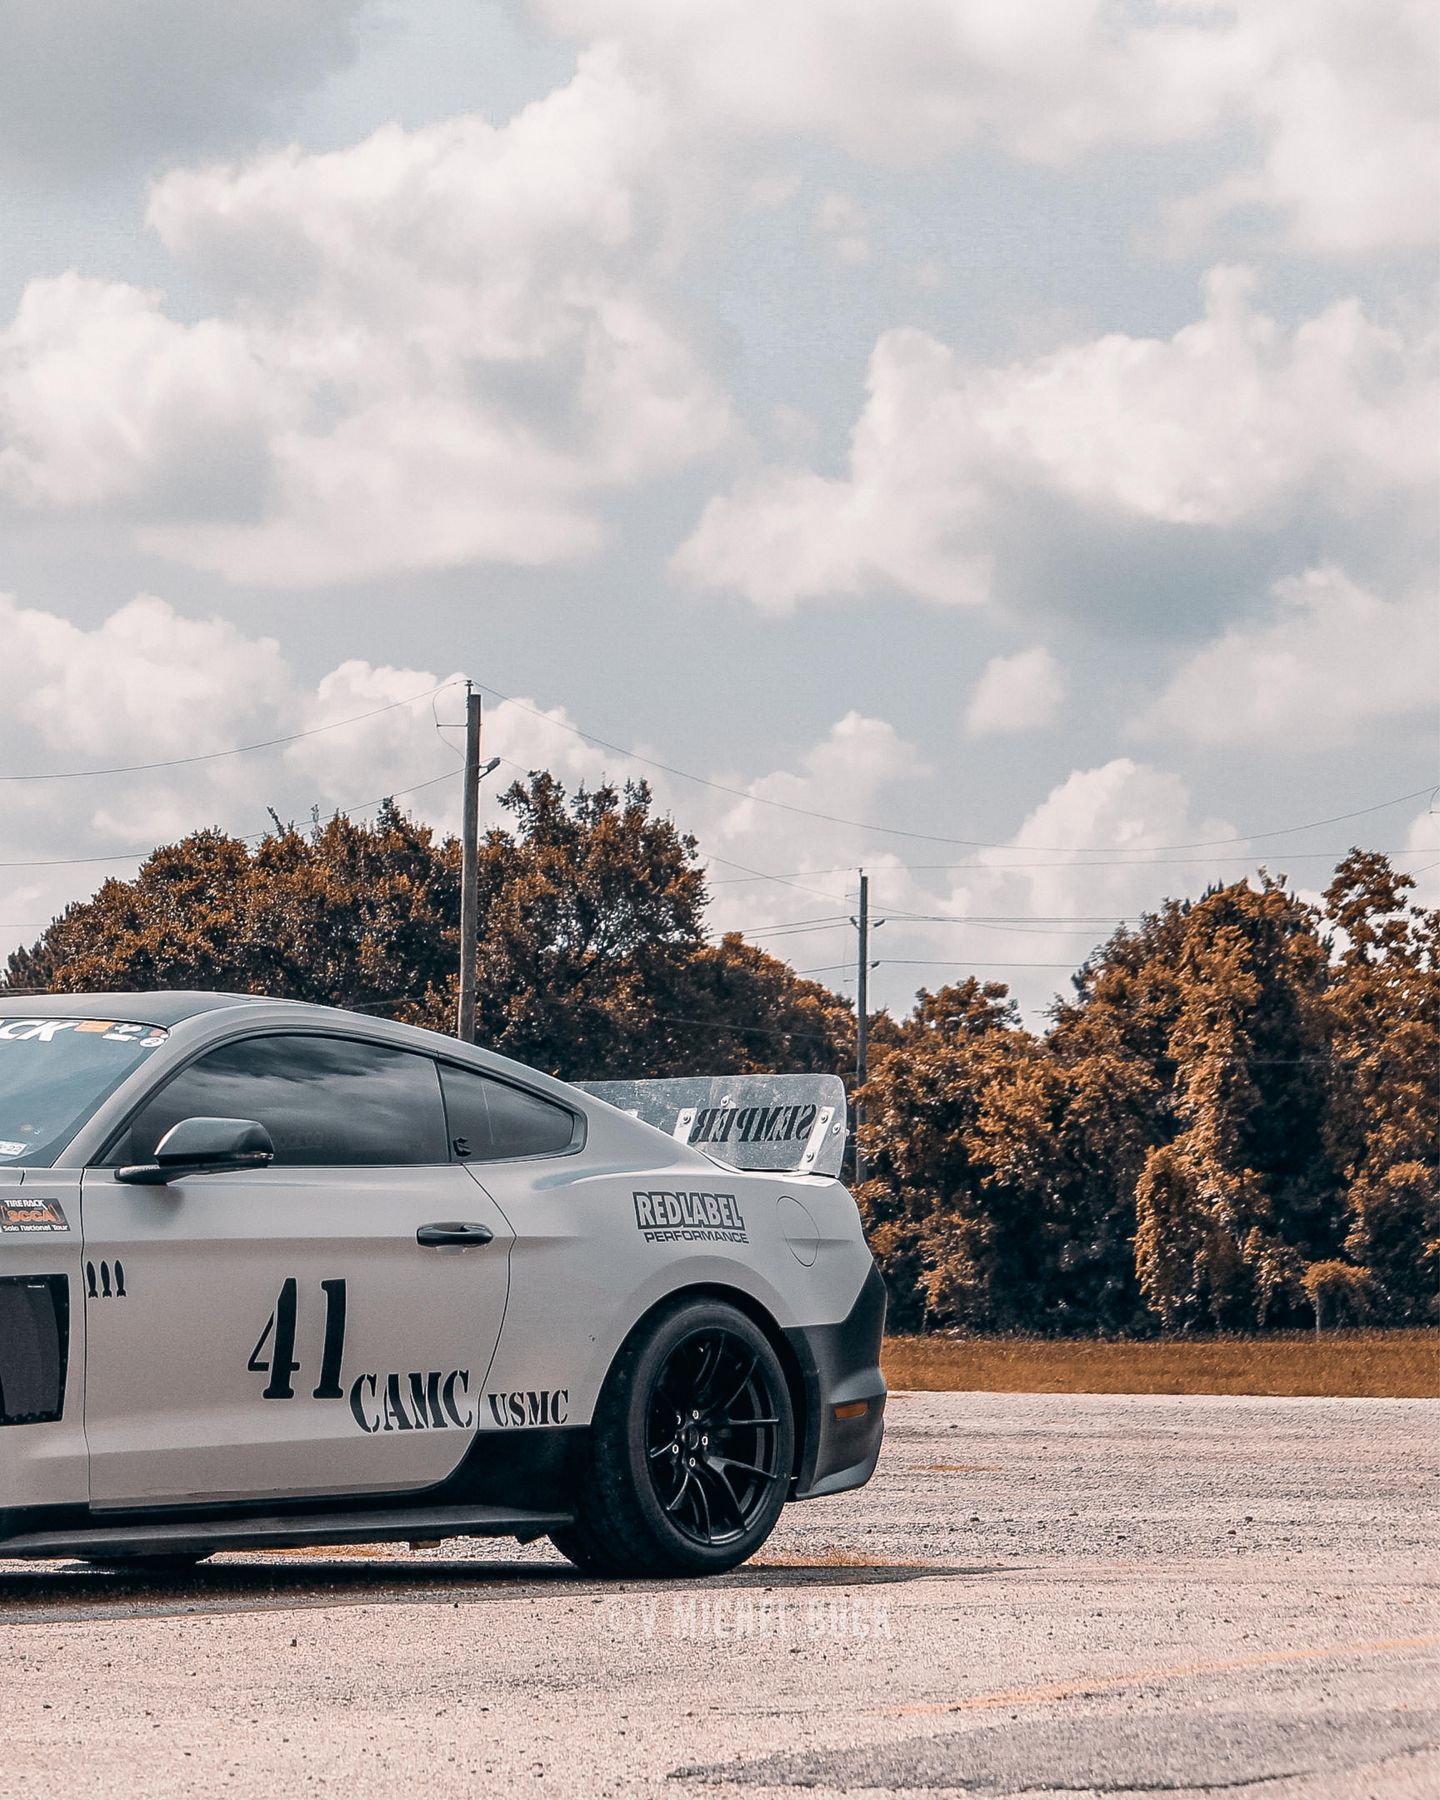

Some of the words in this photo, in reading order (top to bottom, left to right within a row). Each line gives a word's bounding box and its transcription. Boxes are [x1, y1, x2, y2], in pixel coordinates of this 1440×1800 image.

[4, 1199, 23, 1208] TIRE
[23, 1199, 48, 1210] RACK
[7, 1209, 57, 1223] SCCA
[633, 1191, 746, 1231] REDLABEL
[2, 1224, 20, 1232] Solo
[644, 1230, 750, 1244] PERFORMANCE
[247, 1276, 347, 1400] 41
[349, 1369, 473, 1433] CAMC
[487, 1389, 569, 1427] USMC
